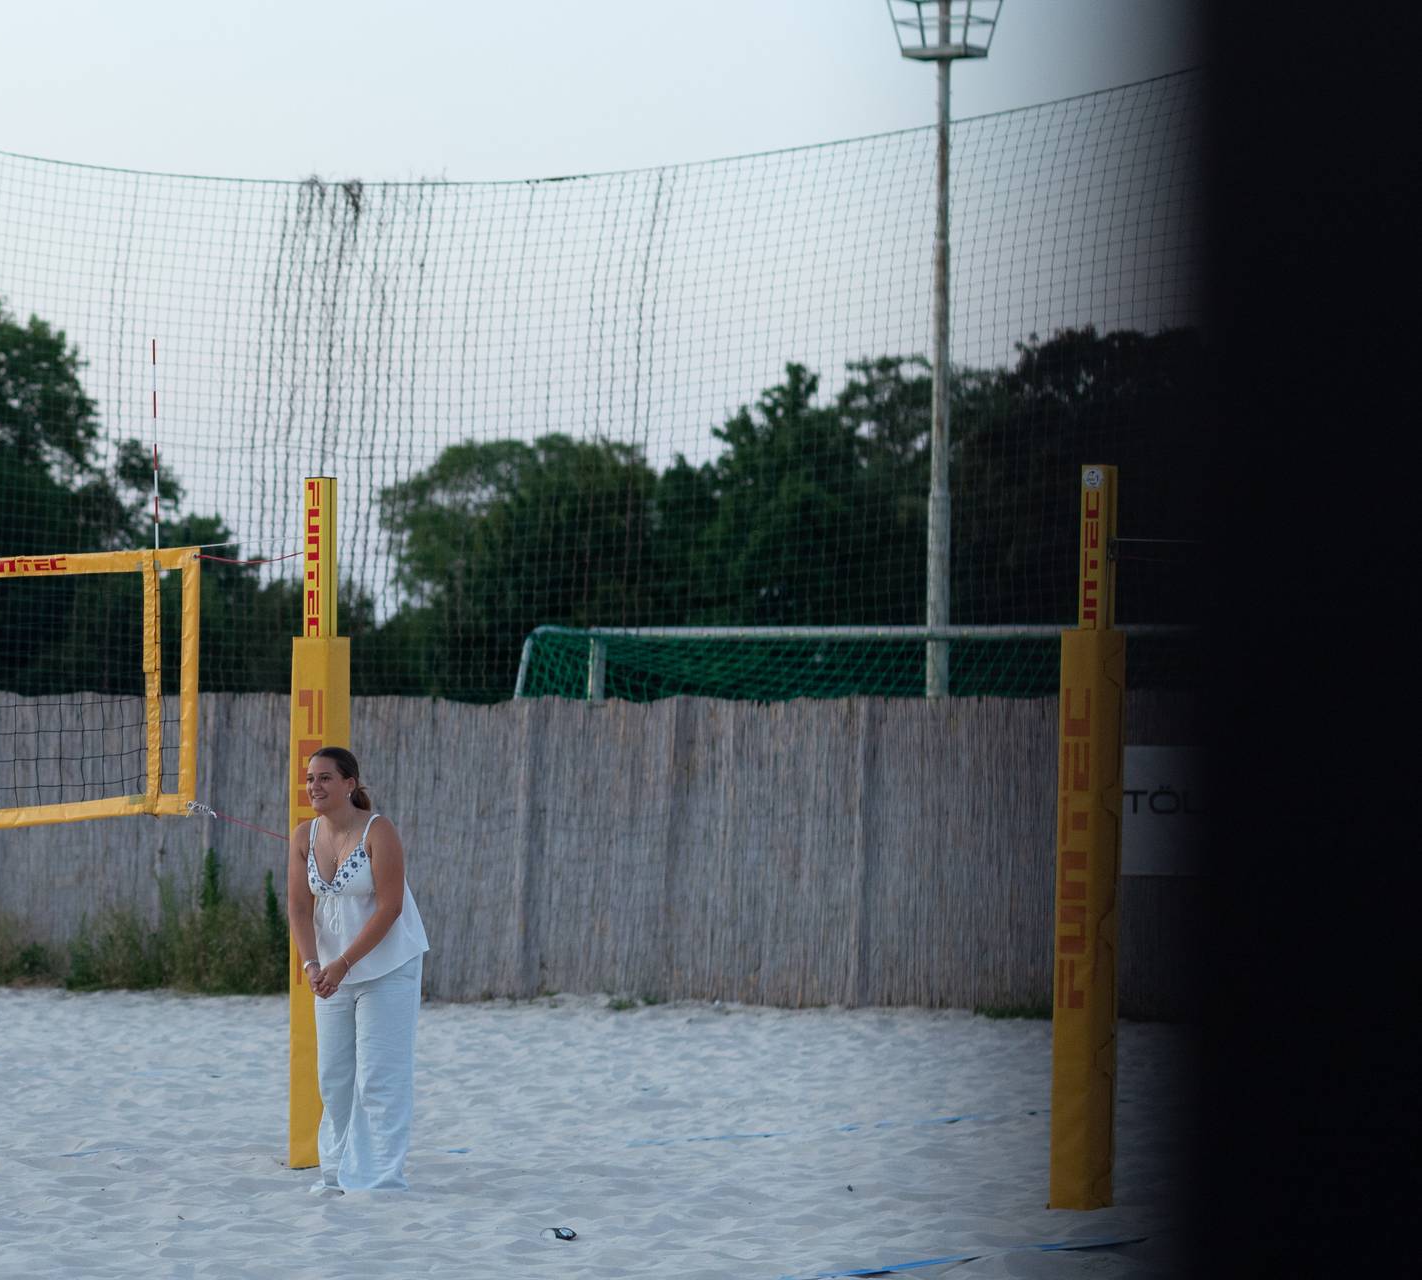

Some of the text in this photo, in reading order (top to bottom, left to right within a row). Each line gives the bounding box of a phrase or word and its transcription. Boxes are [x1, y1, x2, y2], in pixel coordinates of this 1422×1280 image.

[307, 480, 320, 638] FUNTEC
[1083, 491, 1100, 630] UNTEC
[1057, 687, 1091, 1010] FUNTEC
